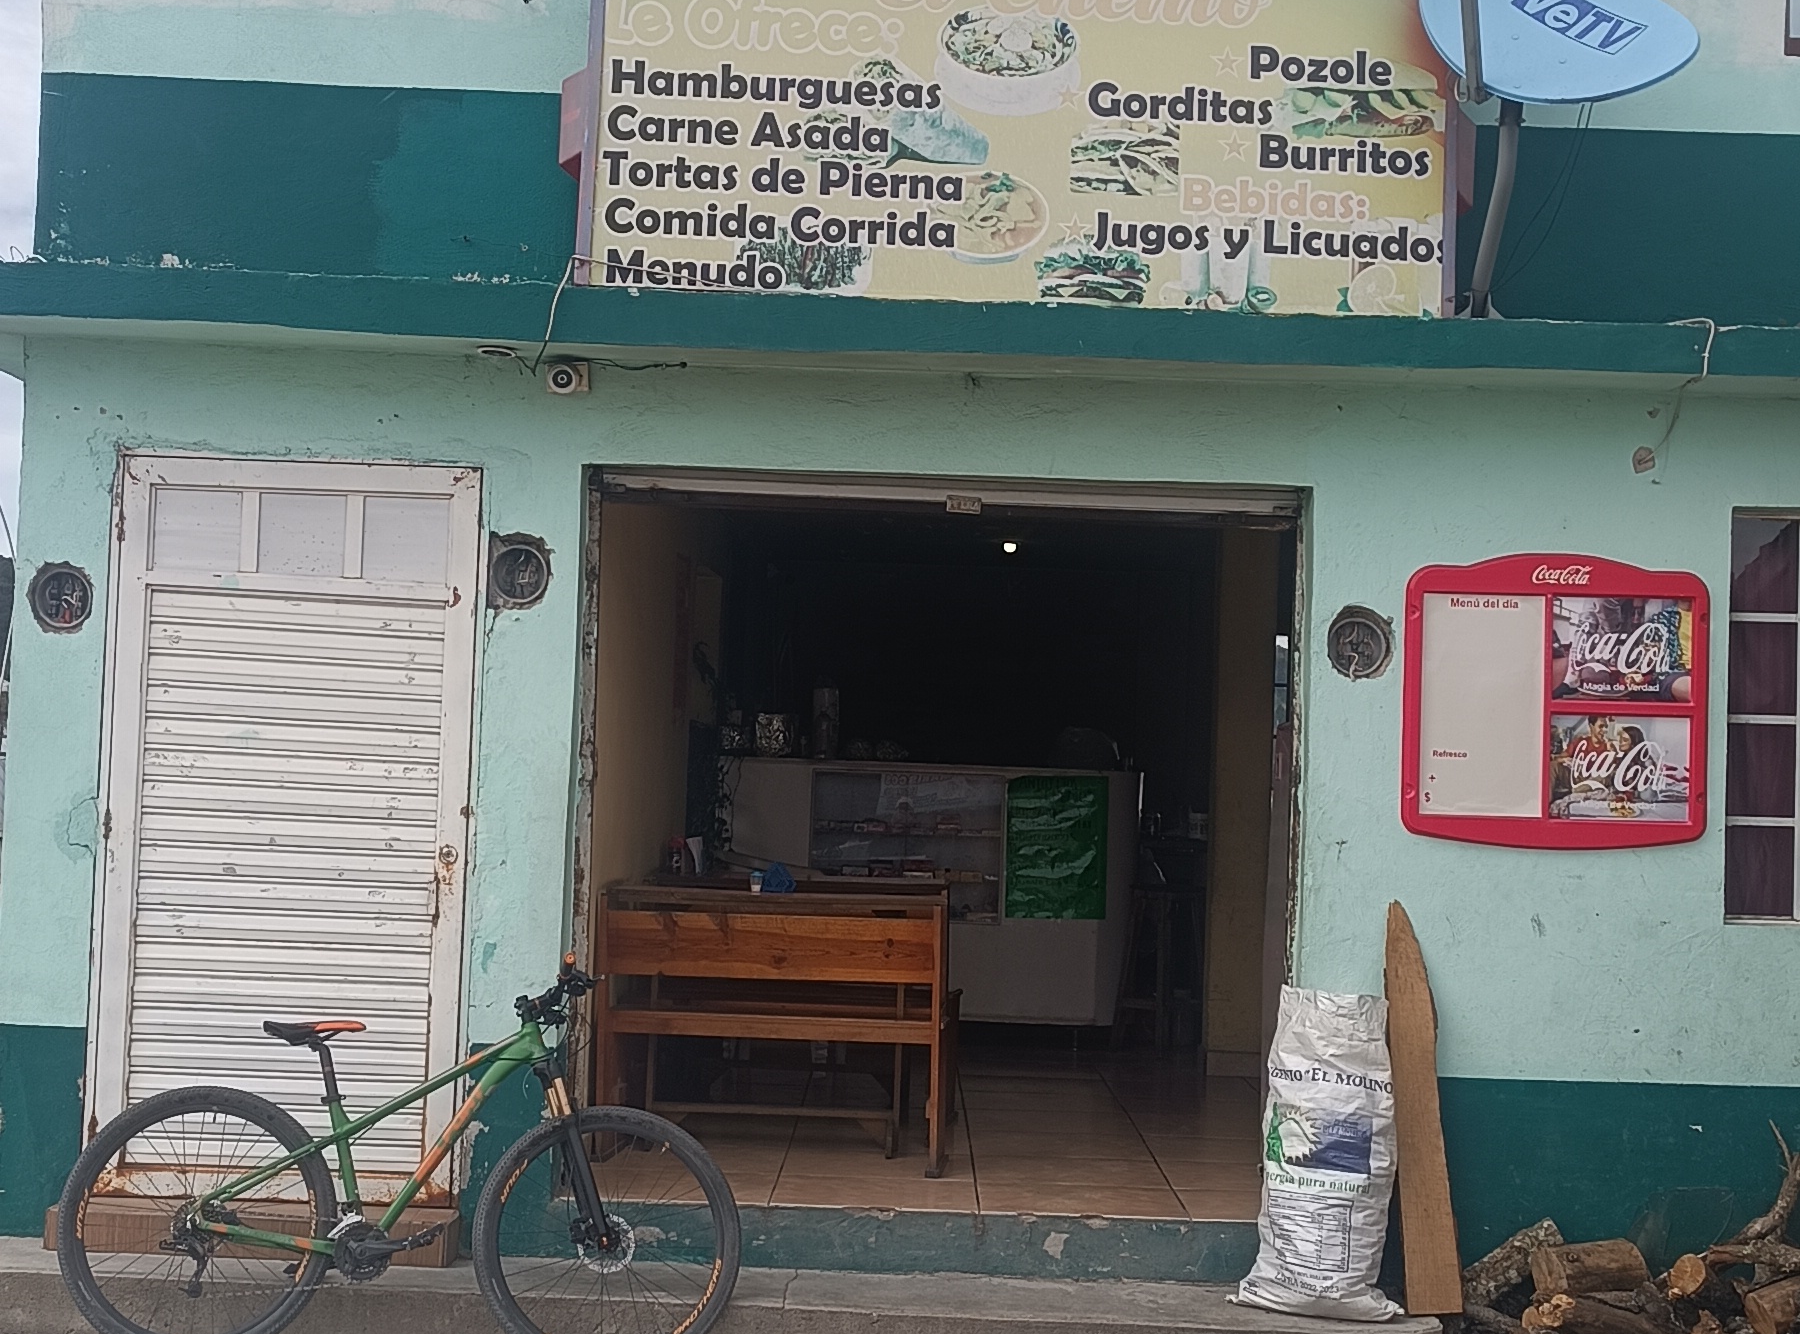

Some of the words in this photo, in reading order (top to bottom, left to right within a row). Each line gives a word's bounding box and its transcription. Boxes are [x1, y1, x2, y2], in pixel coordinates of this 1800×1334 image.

[611, 58, 942, 111] Hamburguesas
[1250, 45, 1393, 86] Pozole
[1088, 81, 1273, 126] Gorditas
[607, 105, 739, 146] Carne
[751, 111, 890, 153] Asada
[603, 150, 738, 192] Tortas
[752, 158, 806, 195] de
[820, 160, 963, 202] Pierna
[1259, 134, 1430, 177] Burritos
[1181, 176, 1370, 221] Bebidas:
[605, 198, 776, 240] Comida
[790, 206, 956, 248] Corrida
[1093, 212, 1209, 255] Jugos
[1223, 226, 1250, 260] y
[606, 248, 783, 290] Menudo
[1532, 564, 1594, 585] Coca-Cola
[1450, 597, 1480, 608] Menú
[1482, 598, 1500, 609] del
[1583, 682, 1611, 692] Magia
[1613, 682, 1625, 691] de
[1627, 683, 1660, 692] Verdad
[1432, 749, 1468, 758] Refresco
[1334, 1073, 1394, 1094] MOLINO
[1298, 1175, 1326, 1189] pura
[1329, 1180, 1371, 1195] natural
